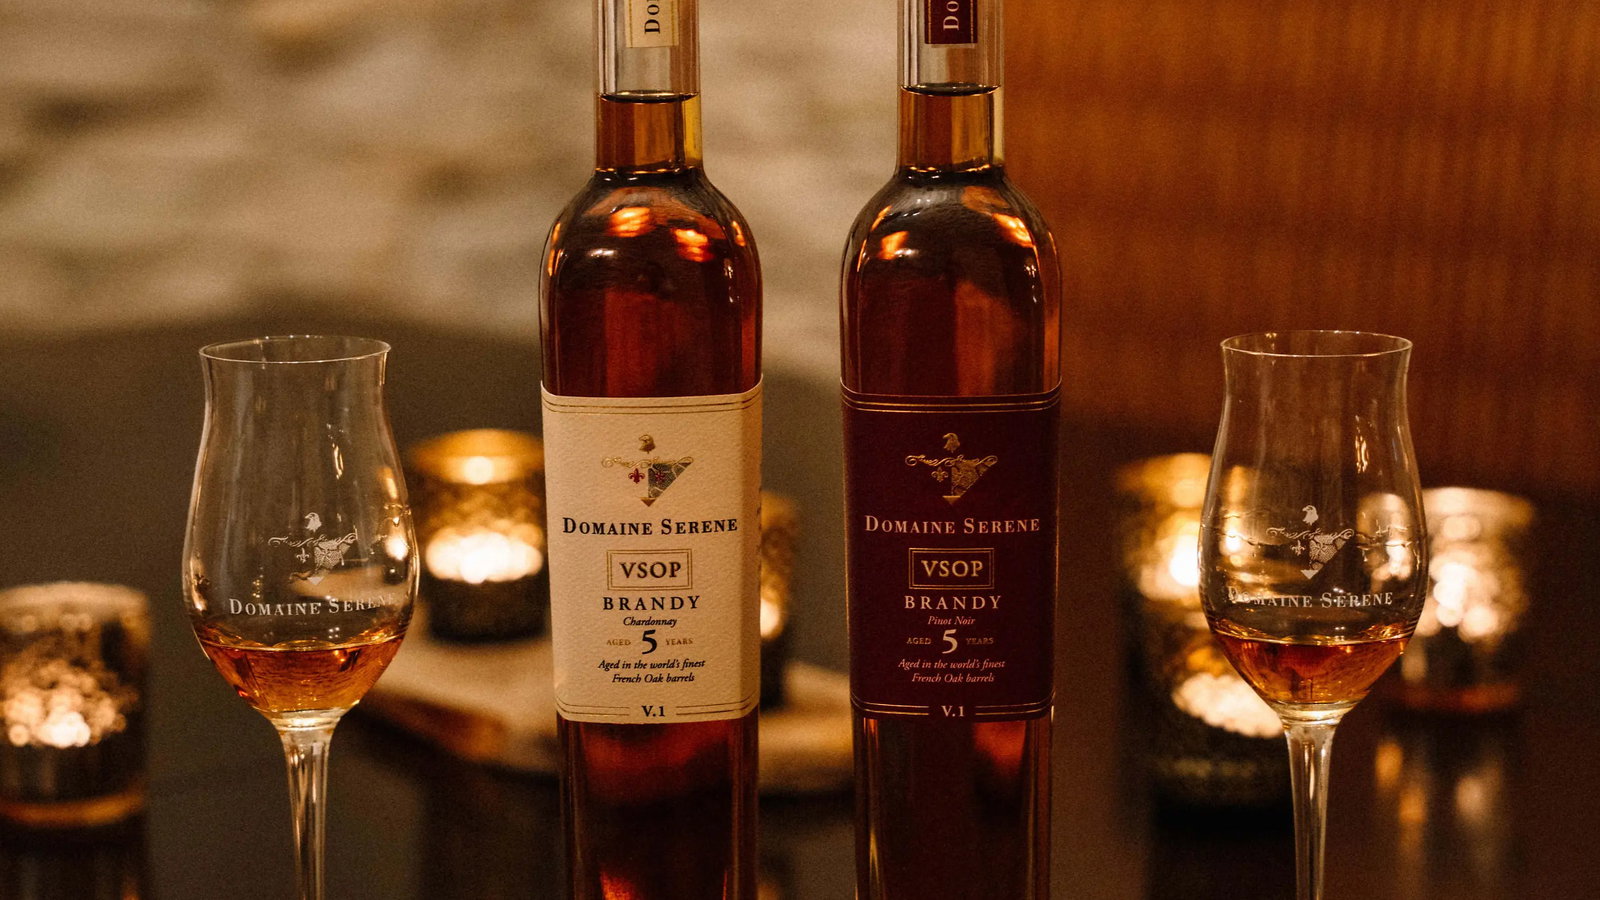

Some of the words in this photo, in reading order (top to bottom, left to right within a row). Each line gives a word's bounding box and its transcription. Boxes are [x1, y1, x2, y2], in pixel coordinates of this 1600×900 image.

[644, 0, 661, 35] DO
[562, 517, 652, 535] DOMAINE
[661, 518, 738, 535] SERENE
[865, 516, 955, 534] DOMAINE
[963, 517, 1040, 533] SERENE
[620, 561, 681, 578] VSOP
[921, 560, 983, 577] VSOP
[229, 598, 320, 616] DOMAINE
[603, 595, 700, 610] BRANDY
[904, 595, 1002, 610] BRANDY
[1321, 591, 1393, 608] SERENE
[623, 616, 677, 628] Chardonnay
[927, 615, 952, 625] Pinot
[954, 616, 976, 625] Noir
[642, 629, 657, 654] 5
[906, 637, 932, 645] AGED
[942, 629, 958, 654] 5
[965, 637, 994, 645] YEARS
[598, 660, 620, 672] Aged
[622, 660, 631, 669] in
[633, 659, 648, 669] the
[681, 659, 705, 671] finest
[898, 658, 920, 671] Aged
[921, 660, 932, 669] in
[933, 659, 948, 669] the
[981, 659, 1006, 671] finest
[612, 673, 642, 683] French
[644, 673, 664, 683] Oak
[666, 672, 695, 682] barrels
[911, 673, 942, 683] French
[944, 673, 964, 683] Oak
[966, 672, 995, 682] barrels
[642, 705, 666, 717] V.1
[941, 705, 965, 717] V.1
